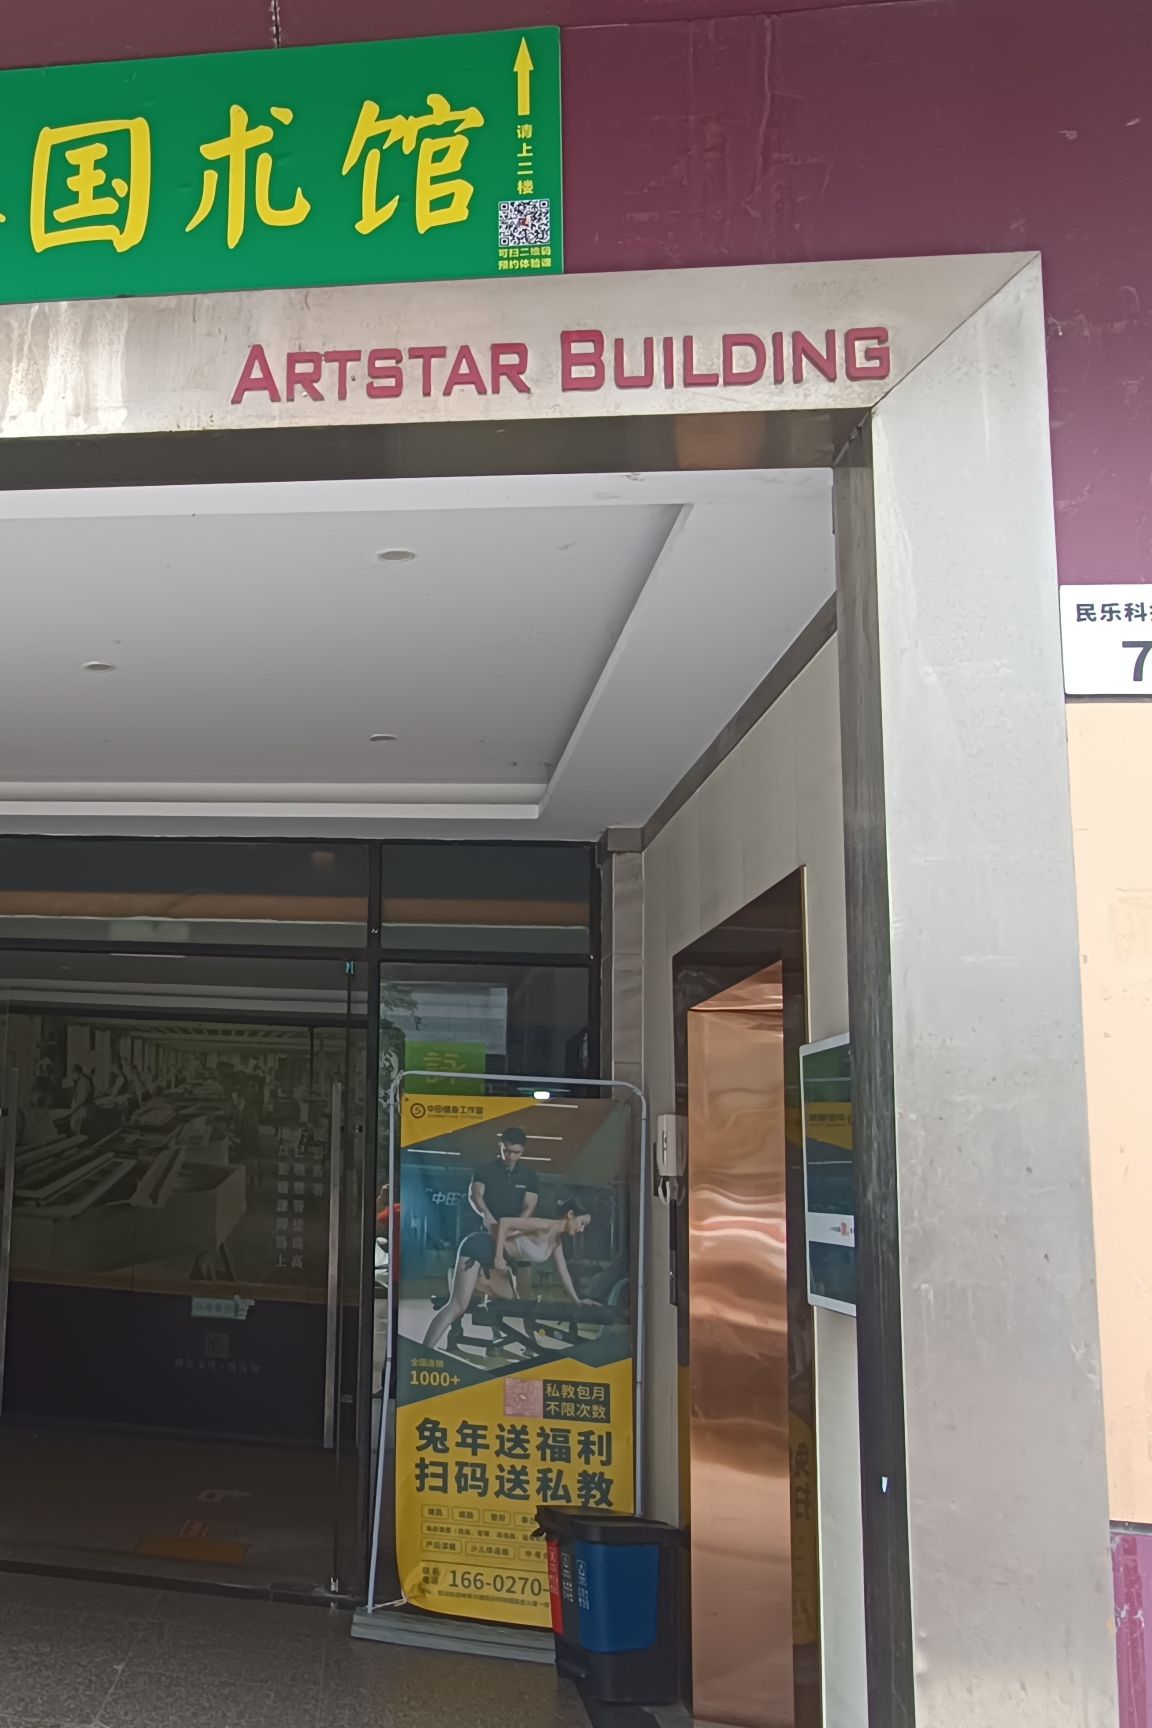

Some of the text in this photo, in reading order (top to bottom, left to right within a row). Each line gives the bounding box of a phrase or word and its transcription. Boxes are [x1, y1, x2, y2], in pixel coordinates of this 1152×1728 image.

[516, 124, 534, 195] 请上二楼
[498, 246, 552, 258] 可扫二维码
[498, 258, 552, 271] 预约体验课
[230, 326, 892, 406] ARTSTAR BUILDING
[1075, 602, 1152, 622] 民乐科
[409, 1371, 461, 1387] 1000+
[545, 1383, 605, 1401] 私教包月
[545, 1401, 607, 1419] 不限次数
[414, 1416, 613, 1468] 兔年送福利
[414, 1457, 615, 1508] 扫码送私教
